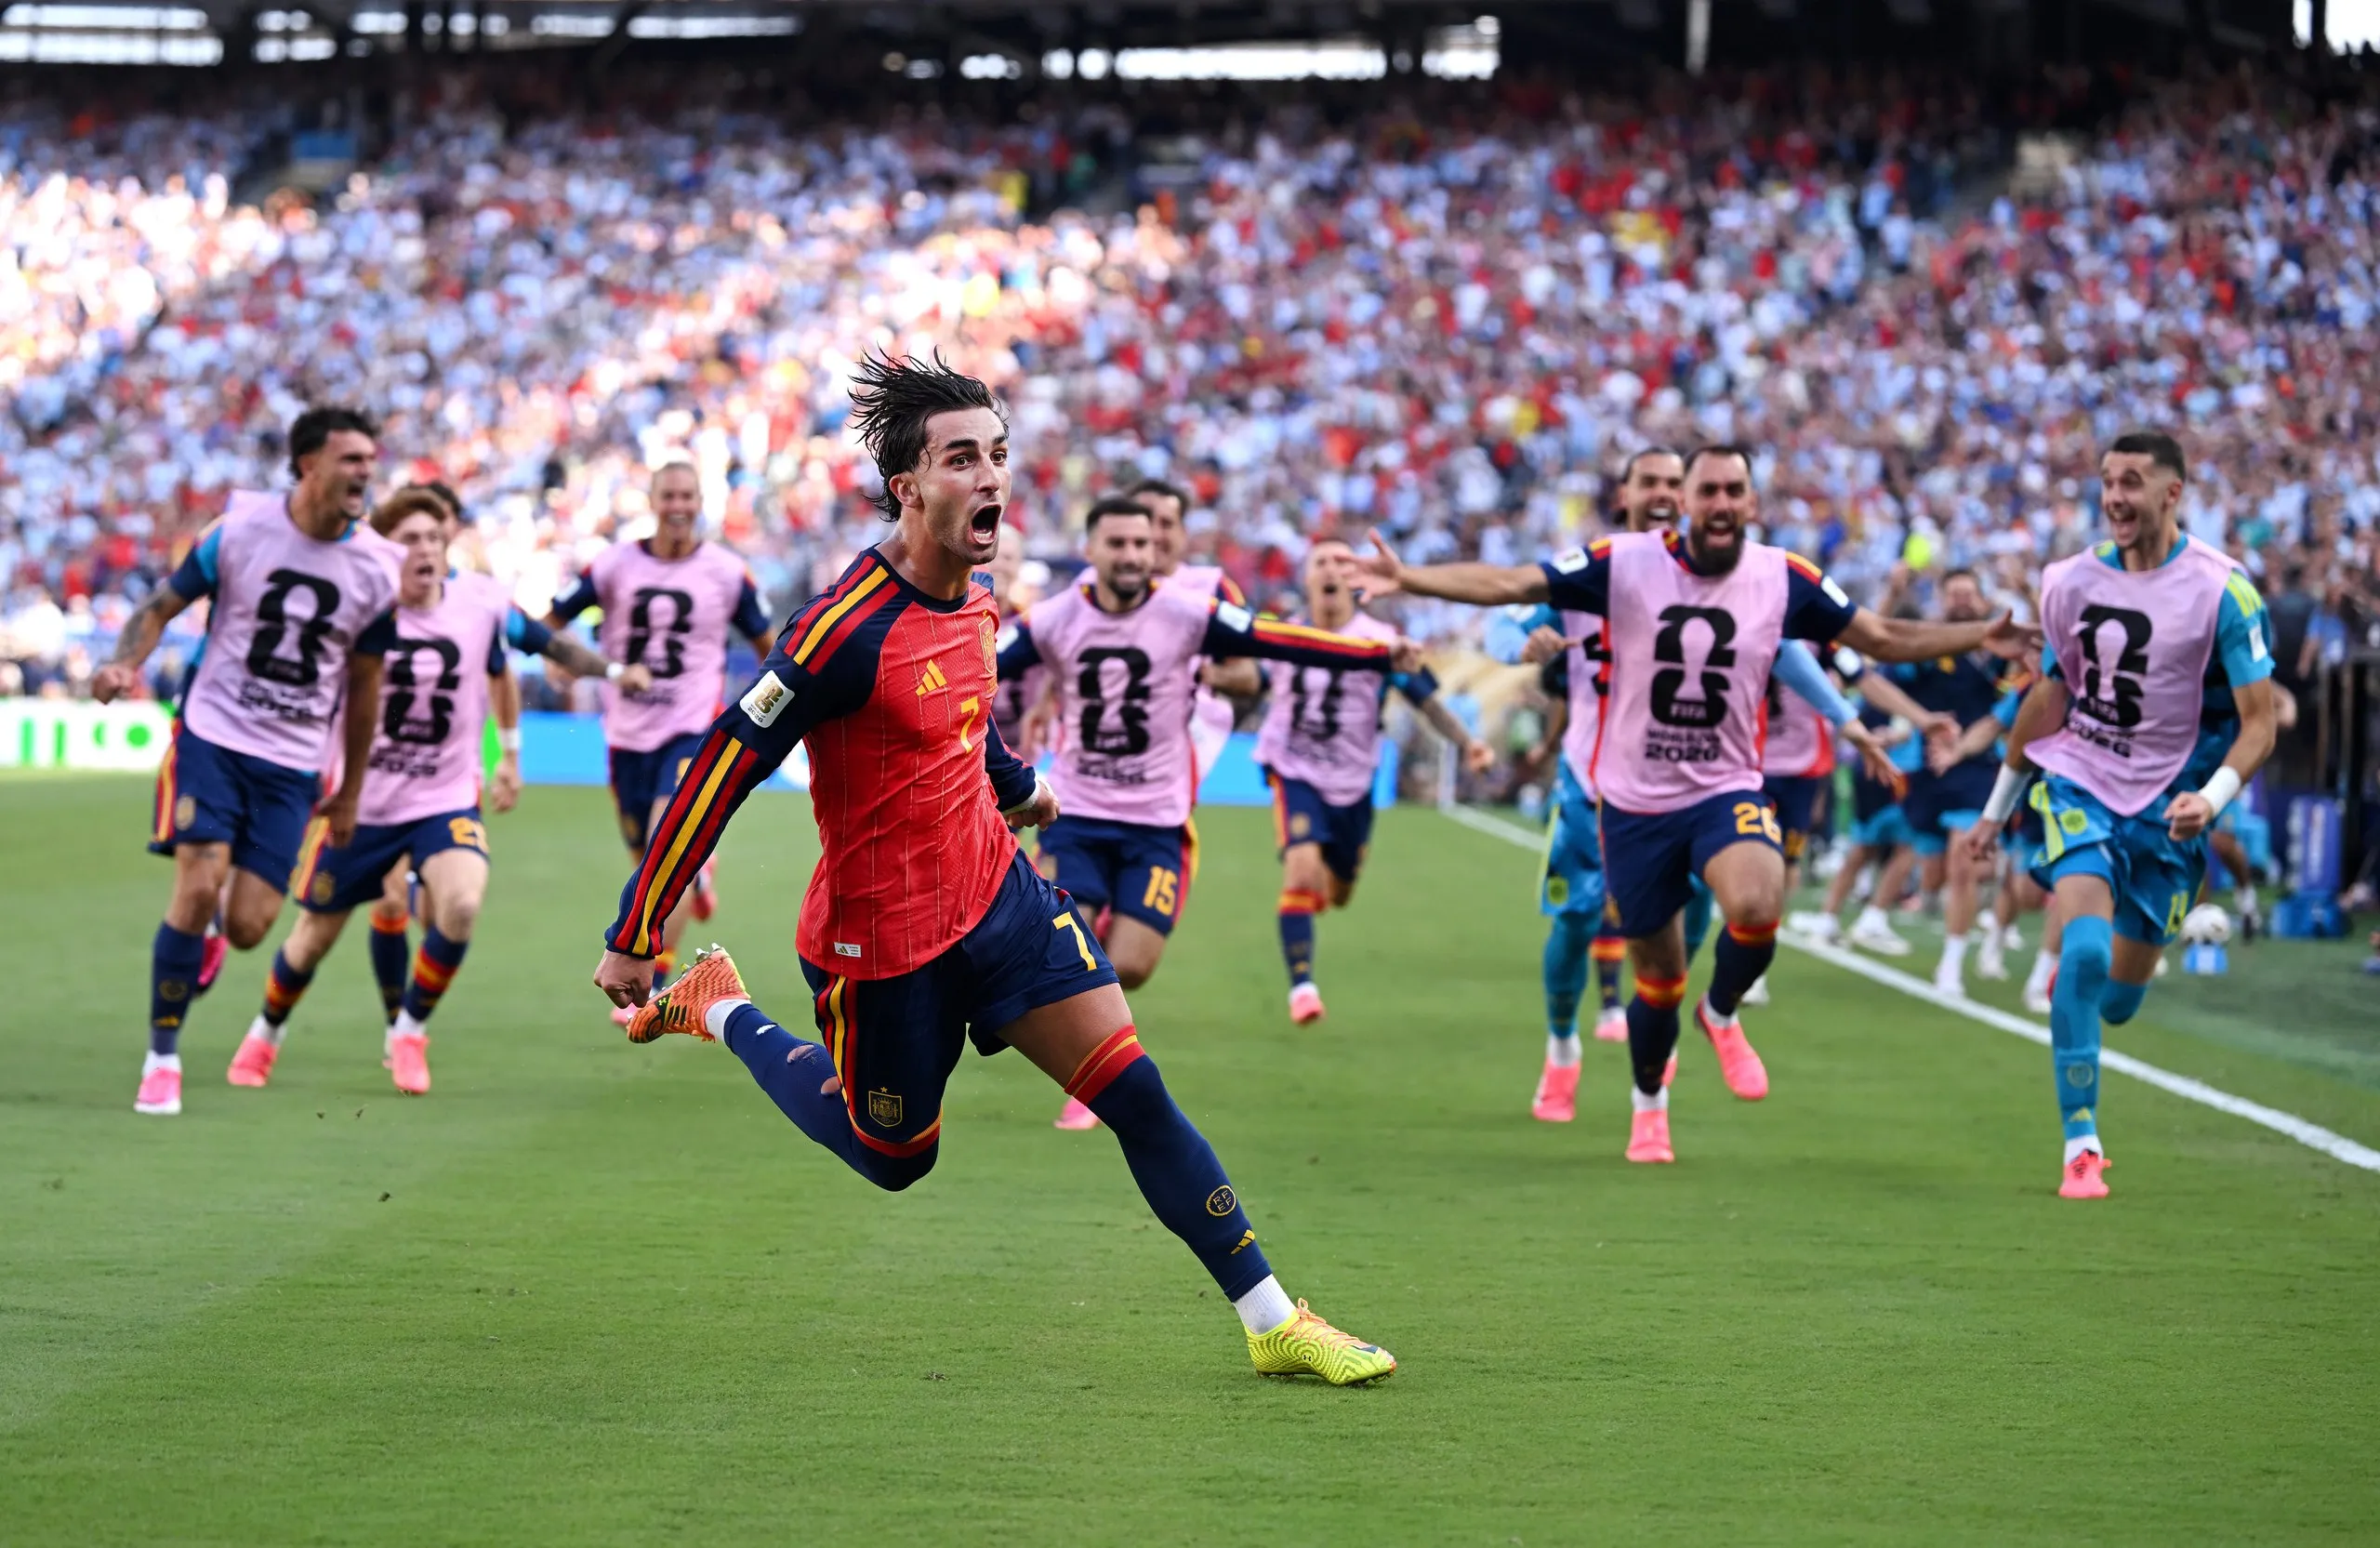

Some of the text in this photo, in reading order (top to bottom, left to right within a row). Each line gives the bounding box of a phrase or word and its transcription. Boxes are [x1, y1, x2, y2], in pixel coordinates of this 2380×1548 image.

[747, 707, 763, 723] 2026
[960, 695, 979, 753] 7
[1143, 866, 1178, 916] 15
[1052, 911, 1097, 972] 7
